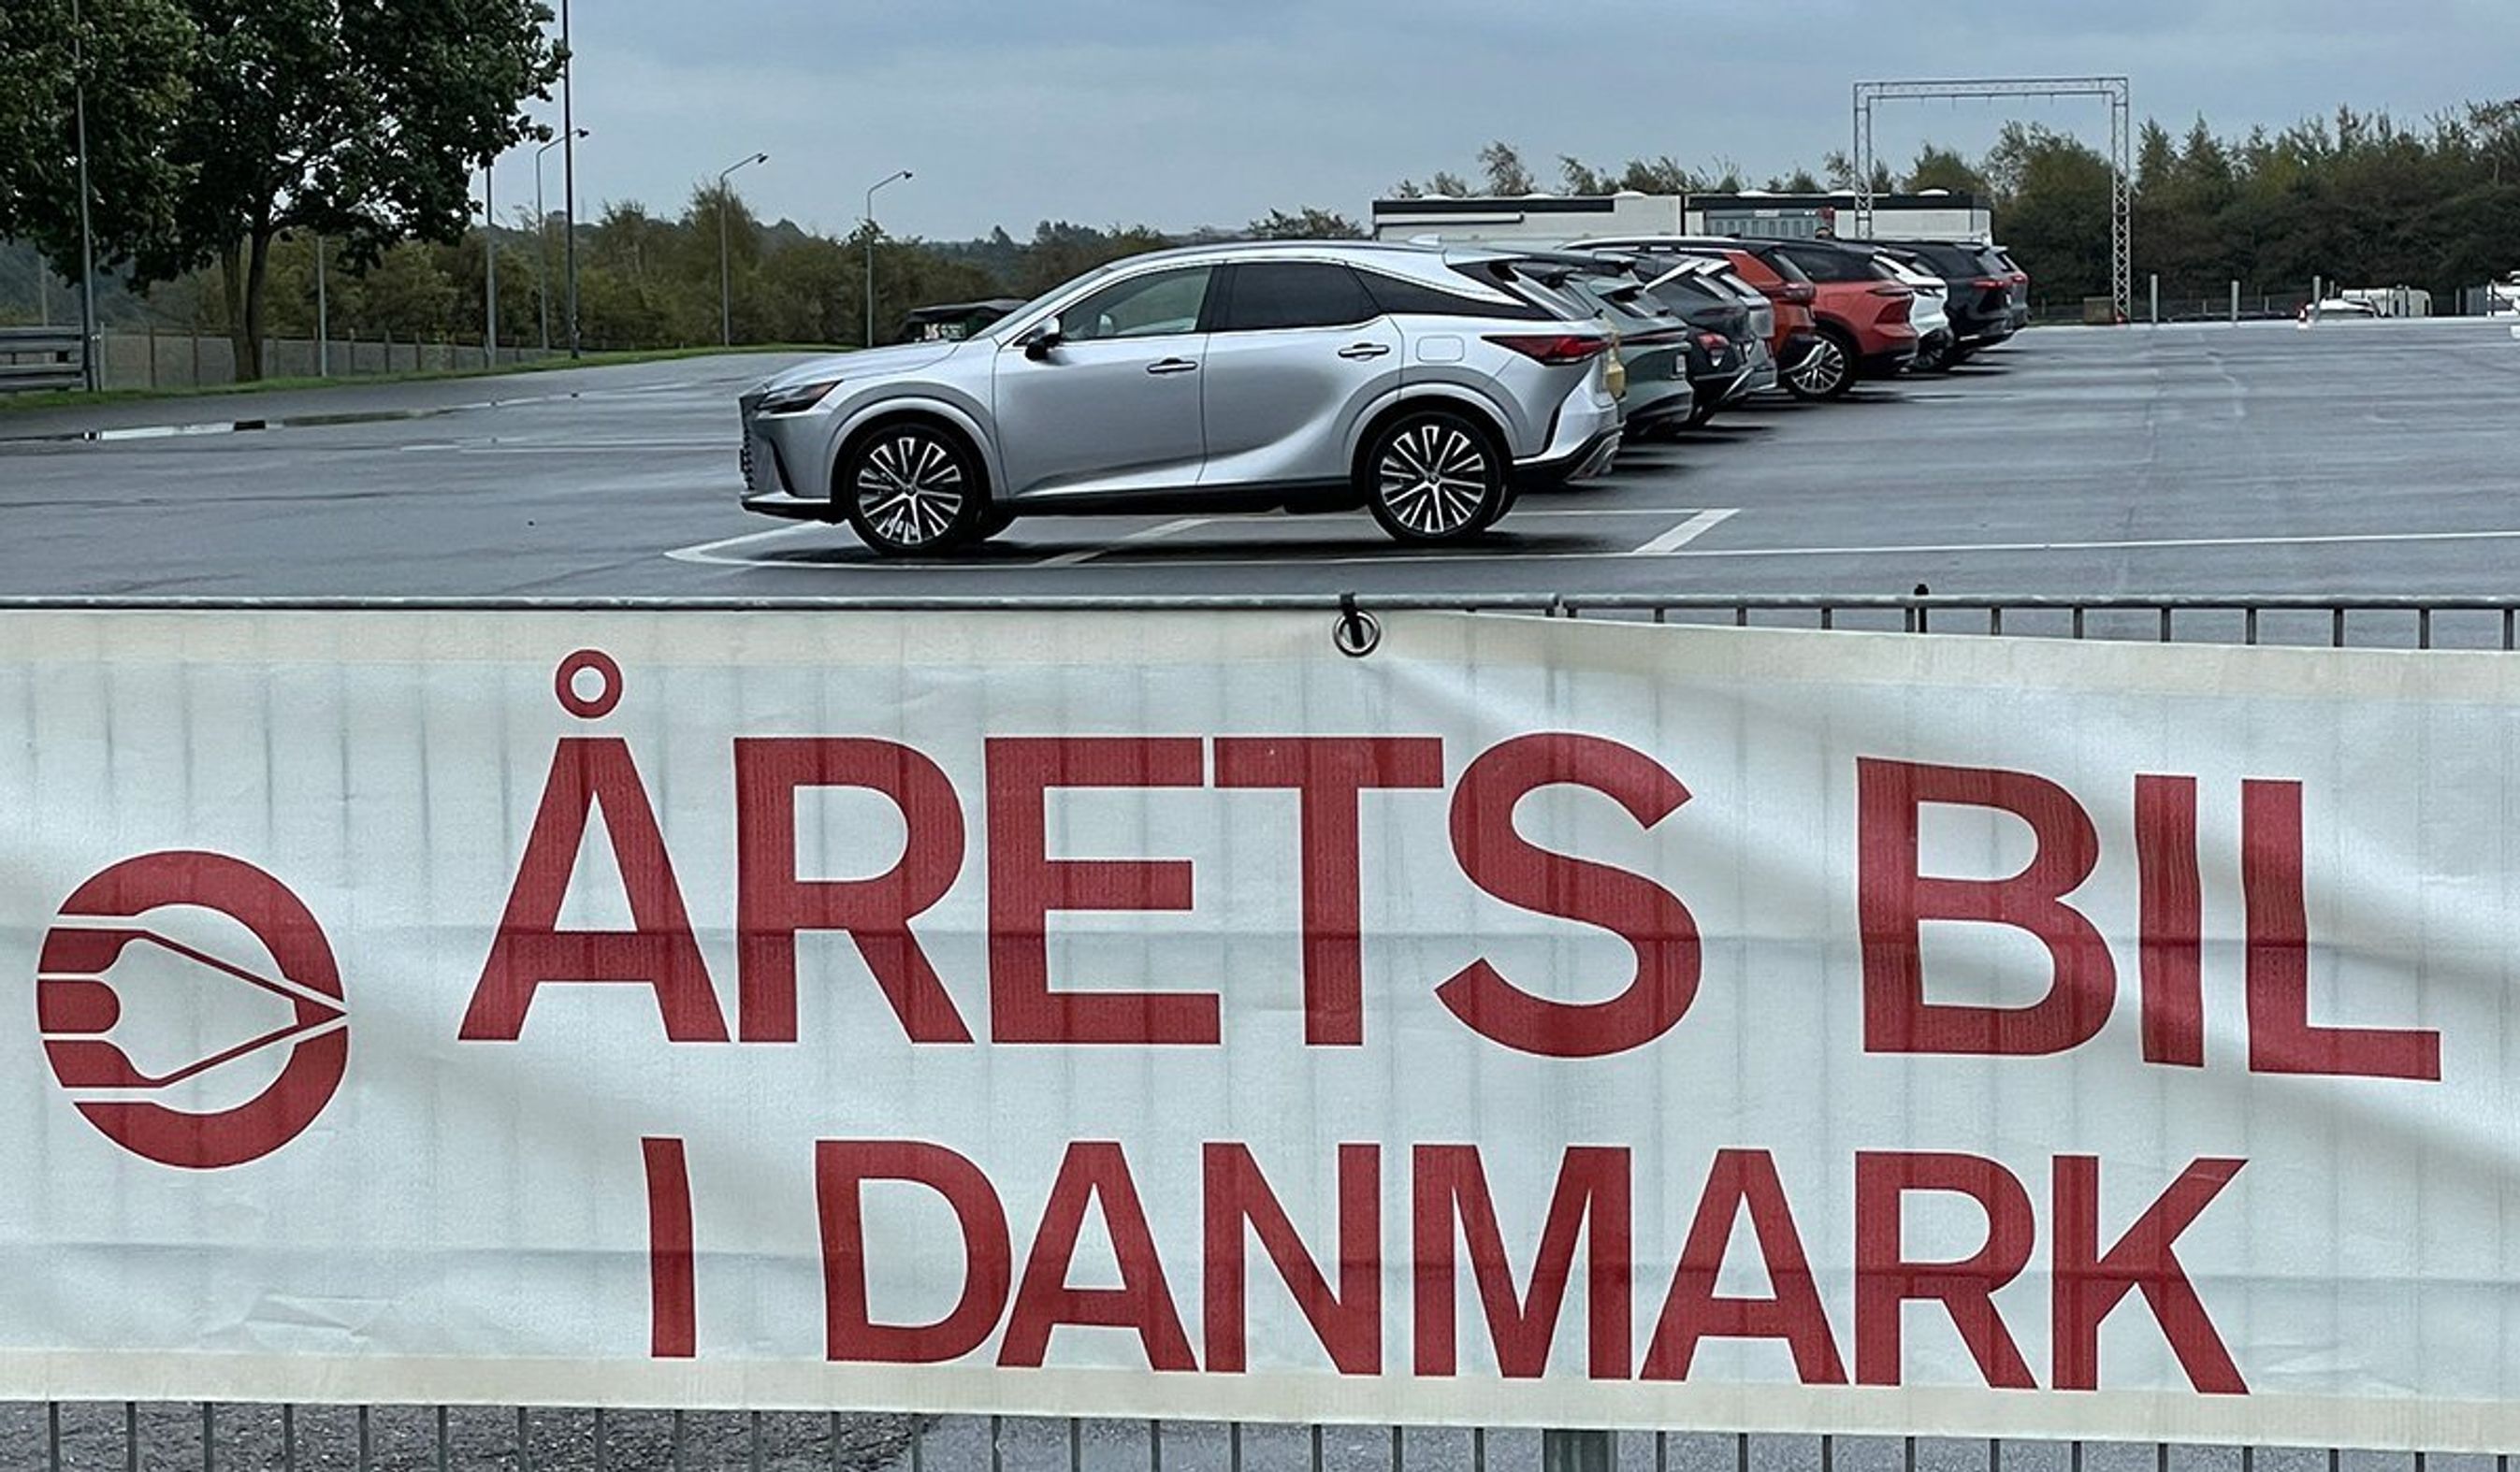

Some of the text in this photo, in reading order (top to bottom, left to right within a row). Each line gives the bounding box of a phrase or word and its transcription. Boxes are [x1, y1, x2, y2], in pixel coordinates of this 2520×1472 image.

[458, 649, 2441, 1081] ÅRETS BIL
[642, 1137, 2250, 1395] I DANMARK
